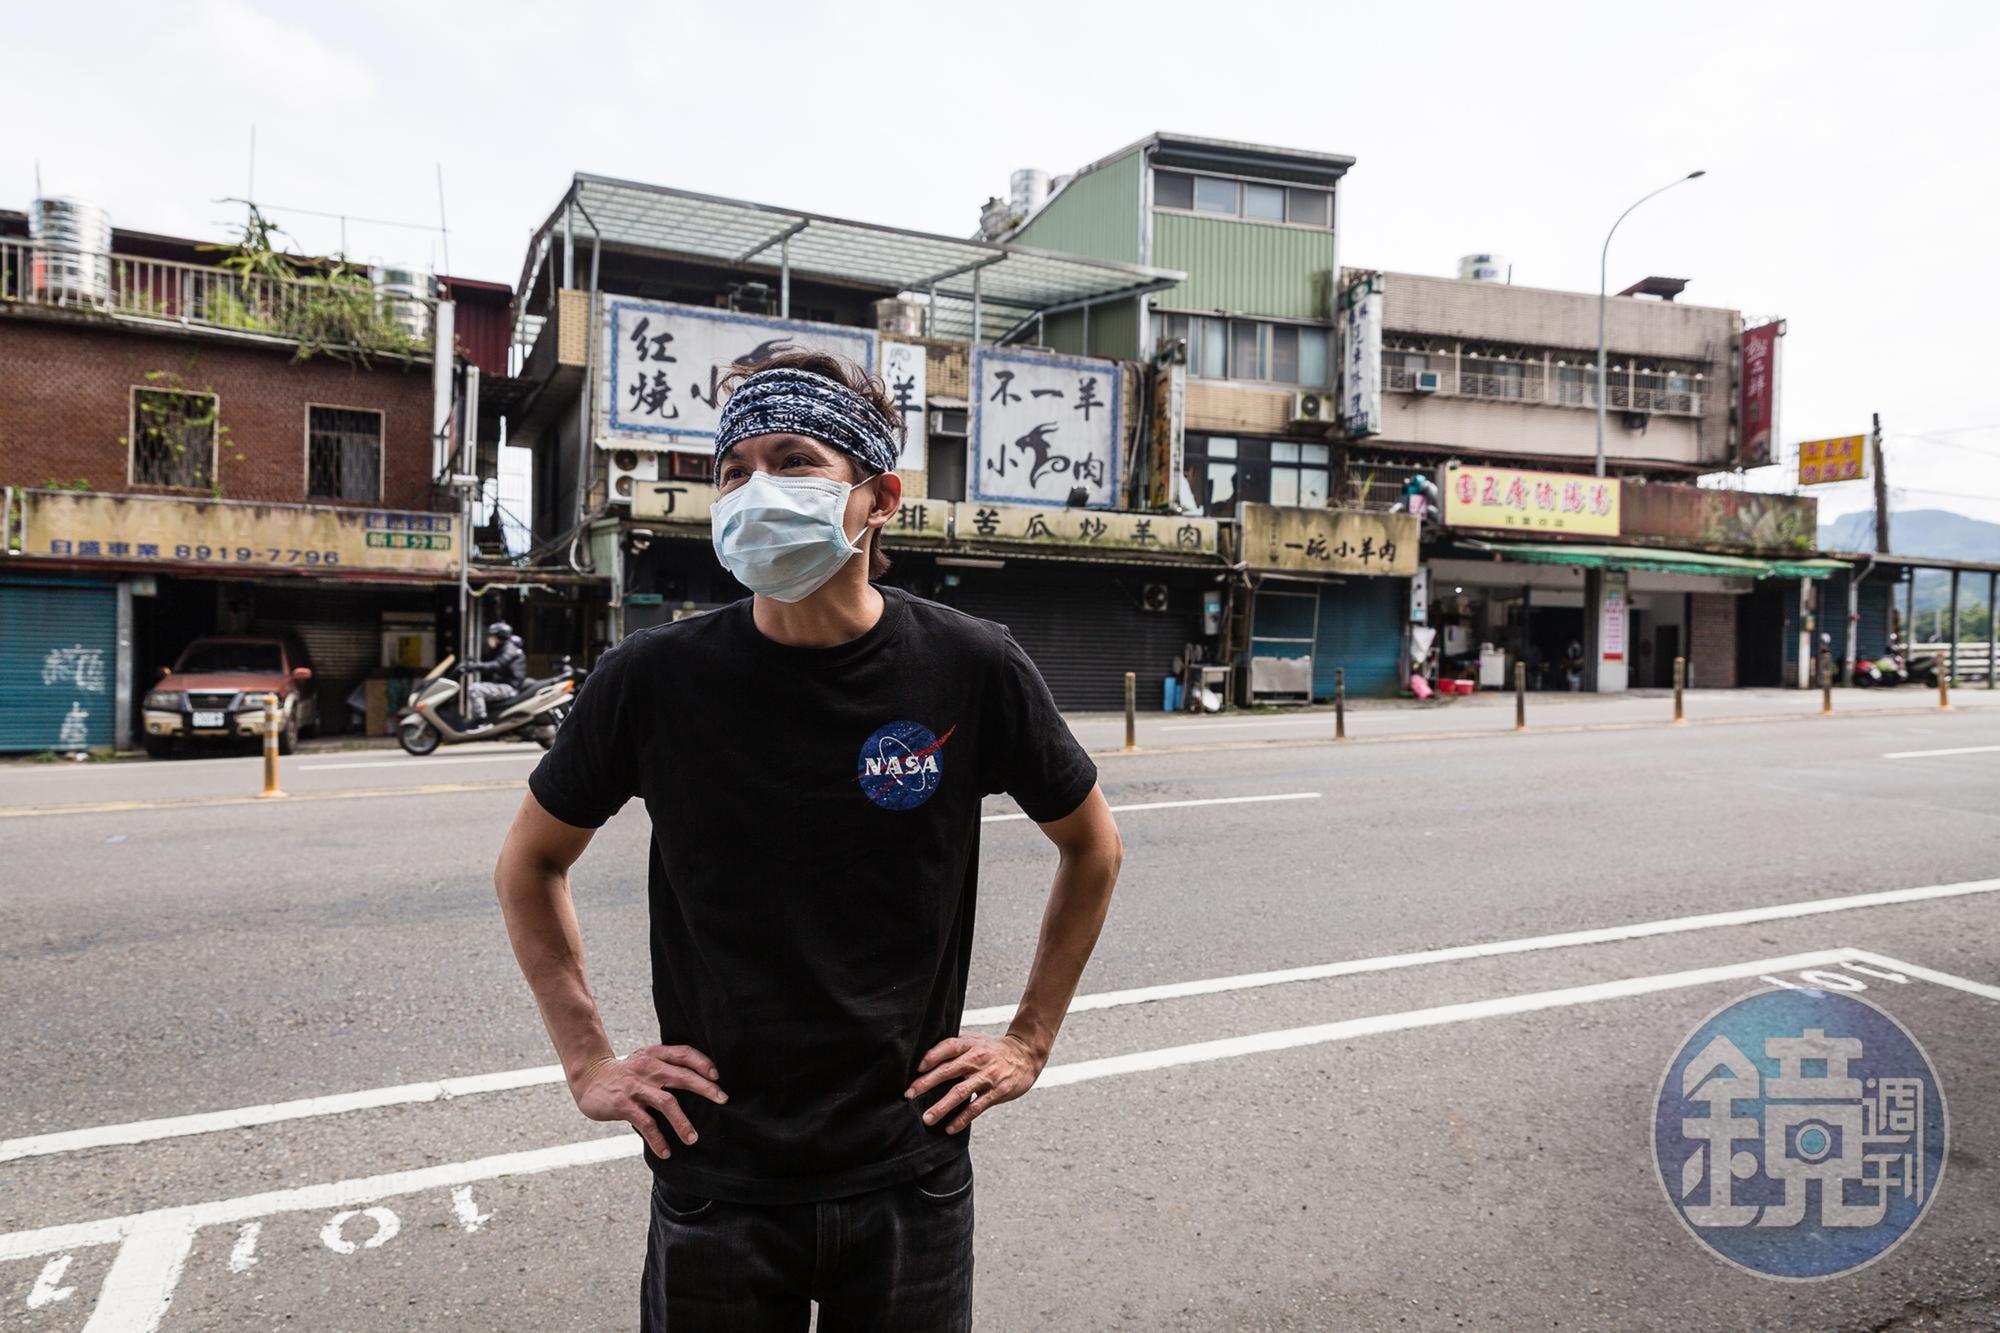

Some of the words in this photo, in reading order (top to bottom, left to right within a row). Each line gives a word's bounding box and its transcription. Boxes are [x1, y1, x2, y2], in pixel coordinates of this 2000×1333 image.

[630, 316, 678, 419] 紅燒
[990, 370, 1104, 421] 不一羊
[972, 508, 1202, 549] 苦瓜炒羊肉
[175, 544, 340, 565] 8919-7796
[1285, 533, 1397, 565] 一碗小羊肉
[864, 755, 940, 776] NASA
